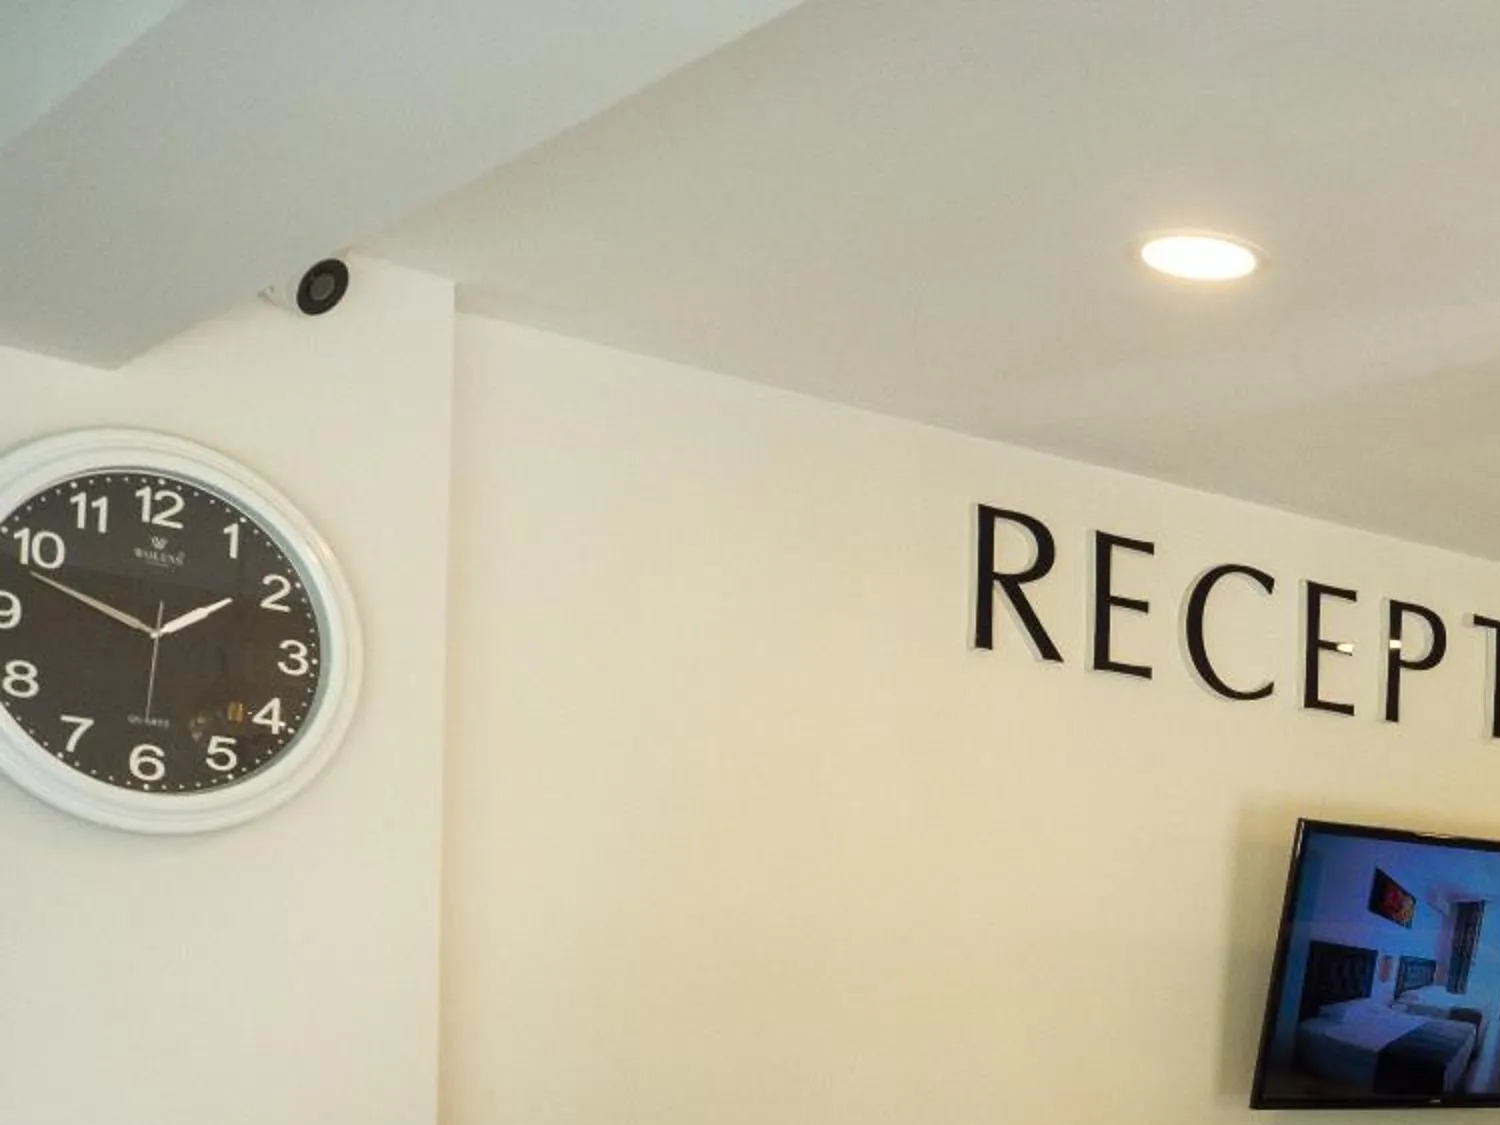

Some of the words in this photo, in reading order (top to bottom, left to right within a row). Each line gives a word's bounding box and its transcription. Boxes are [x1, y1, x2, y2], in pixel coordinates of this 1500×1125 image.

[69, 491, 108, 534] 11
[135, 485, 185, 529] 12
[13, 527, 66, 569] 10
[223, 522, 239, 559] 1
[0, 590, 22, 629] 9
[260, 574, 292, 613] 2
[277, 639, 309, 676] 3
[2, 659, 39, 698] 8
[60, 715, 94, 753] 7
[251, 697, 287, 735] 4
[129, 743, 166, 781] 6
[205, 735, 237, 771] 5
